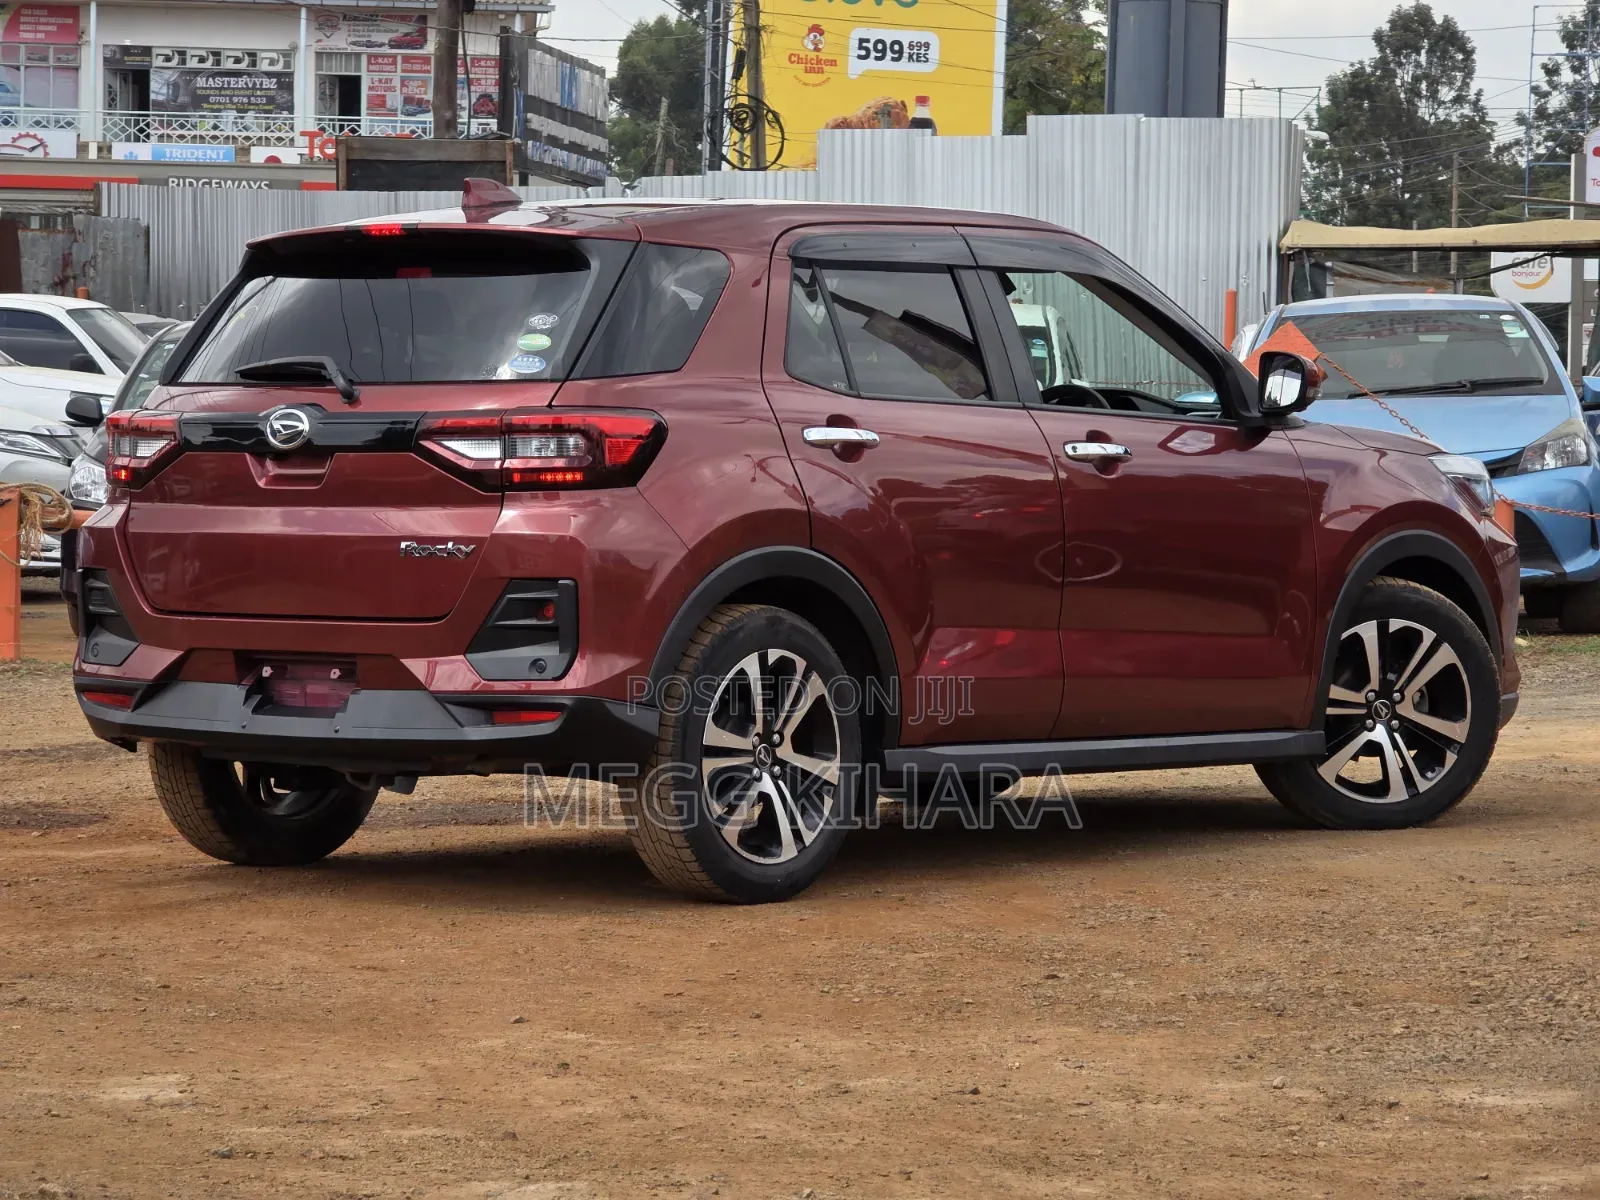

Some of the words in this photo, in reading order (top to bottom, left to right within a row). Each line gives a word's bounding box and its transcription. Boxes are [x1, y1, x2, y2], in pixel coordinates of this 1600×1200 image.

[856, 37, 904, 62] 599
[908, 41, 931, 51] 699
[788, 52, 838, 67] Chicken
[908, 52, 929, 63] KES
[196, 77, 278, 89] MASTERVYBZ
[371, 77, 394, 85] L-KAY
[232, 96, 248, 104] 976
[164, 148, 227, 159] TRIDENT
[1512, 270, 1542, 279] bonjour
[400, 541, 476, 559] Rocky
